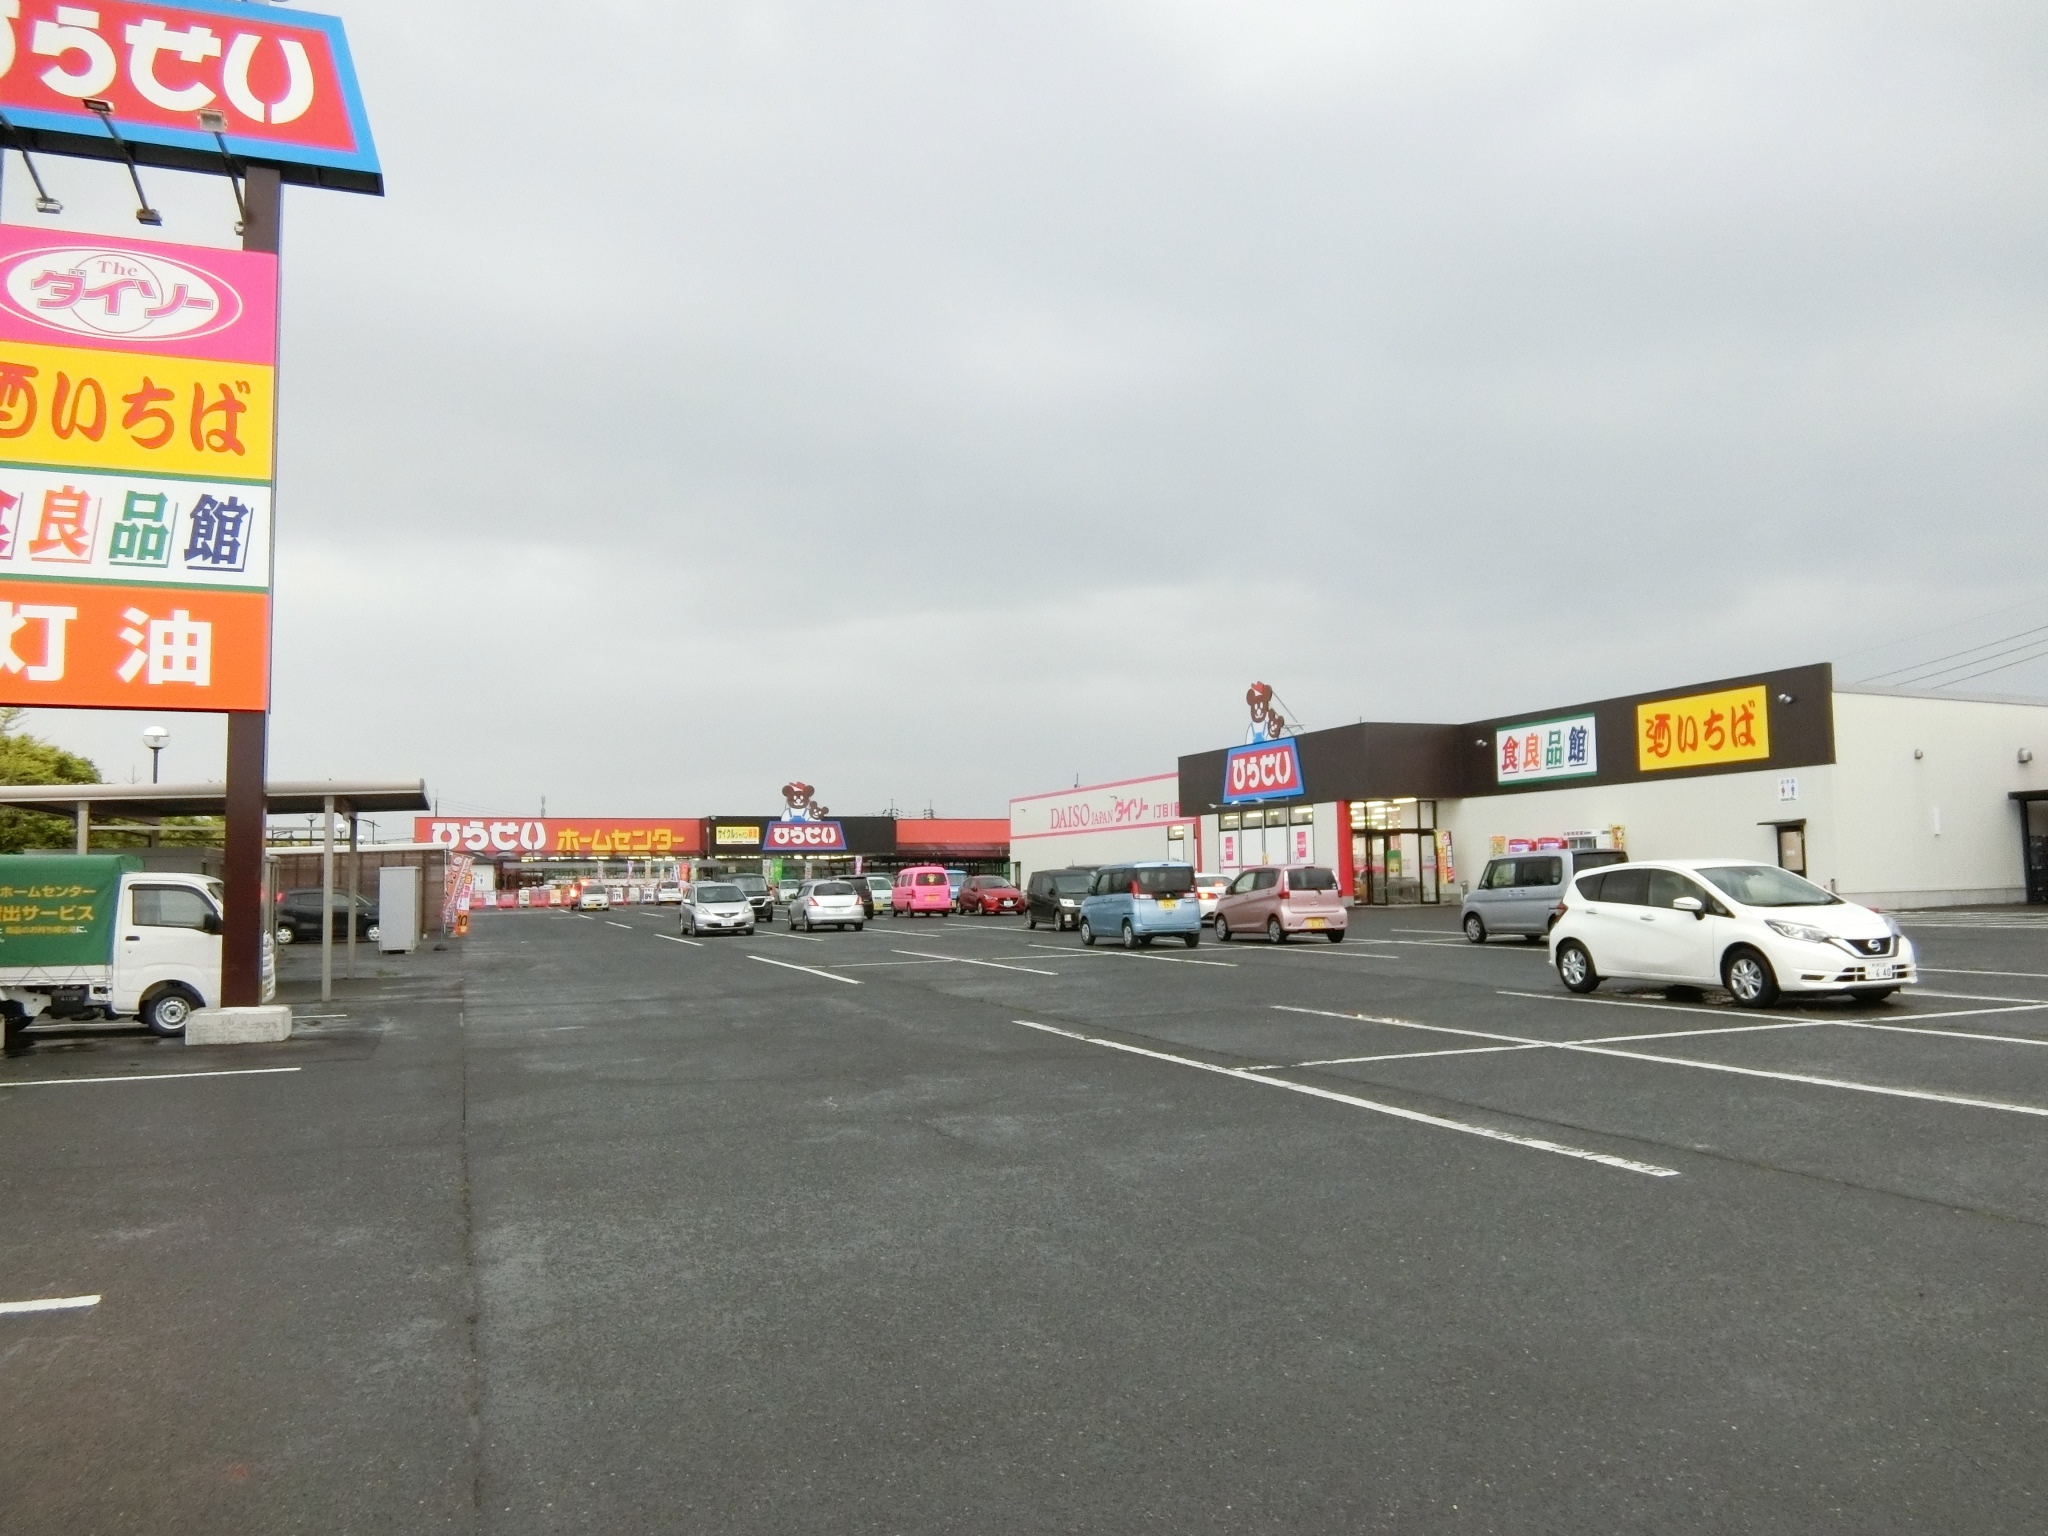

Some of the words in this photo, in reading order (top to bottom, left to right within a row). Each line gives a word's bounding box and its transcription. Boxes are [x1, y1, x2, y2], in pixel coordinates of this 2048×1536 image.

[0, 1, 314, 125] らせい
[97, 260, 138, 277] The
[30, 268, 214, 320] ダイソー
[1645, 699, 1756, 759] 酒いちば
[1502, 725, 1588, 774] 食良品館
[1050, 804, 1090, 829] DAISO
[1091, 810, 1113, 825] JAPAN
[1114, 798, 1149, 822] ダイソー
[557, 829, 685, 850] ホームセンター
[0, 905, 94, 922] 出サービス
